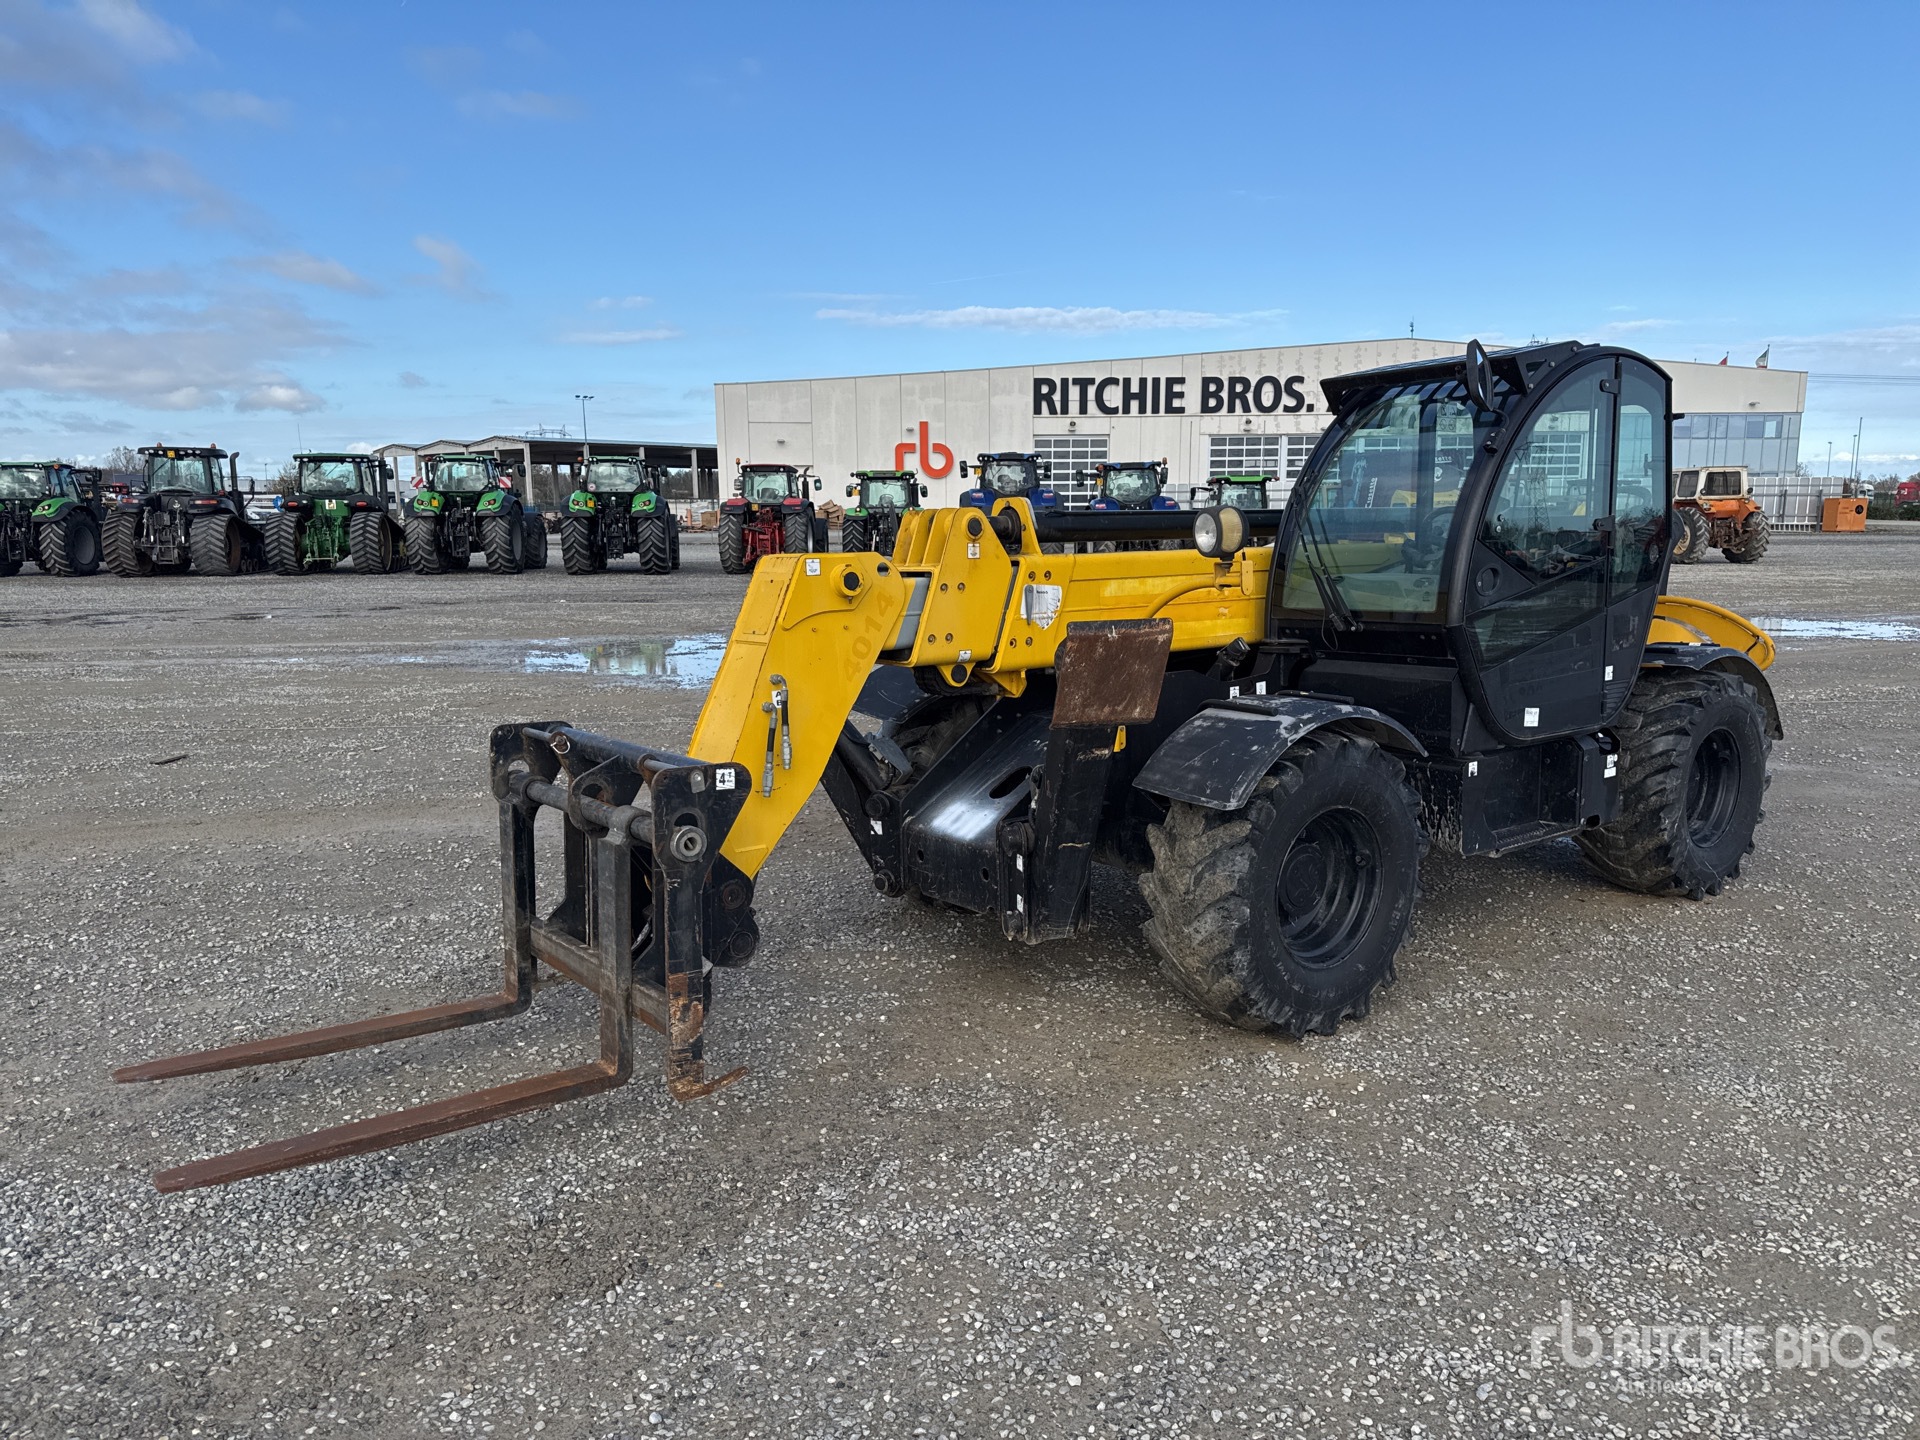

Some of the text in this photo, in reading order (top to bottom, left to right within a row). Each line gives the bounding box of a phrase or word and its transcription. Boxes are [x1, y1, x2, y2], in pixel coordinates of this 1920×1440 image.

[1033, 376, 1314, 415] RITCHIE BROS.
[895, 421, 954, 479] rb
[844, 590, 895, 682] 4014
[719, 772, 726, 785] 4
